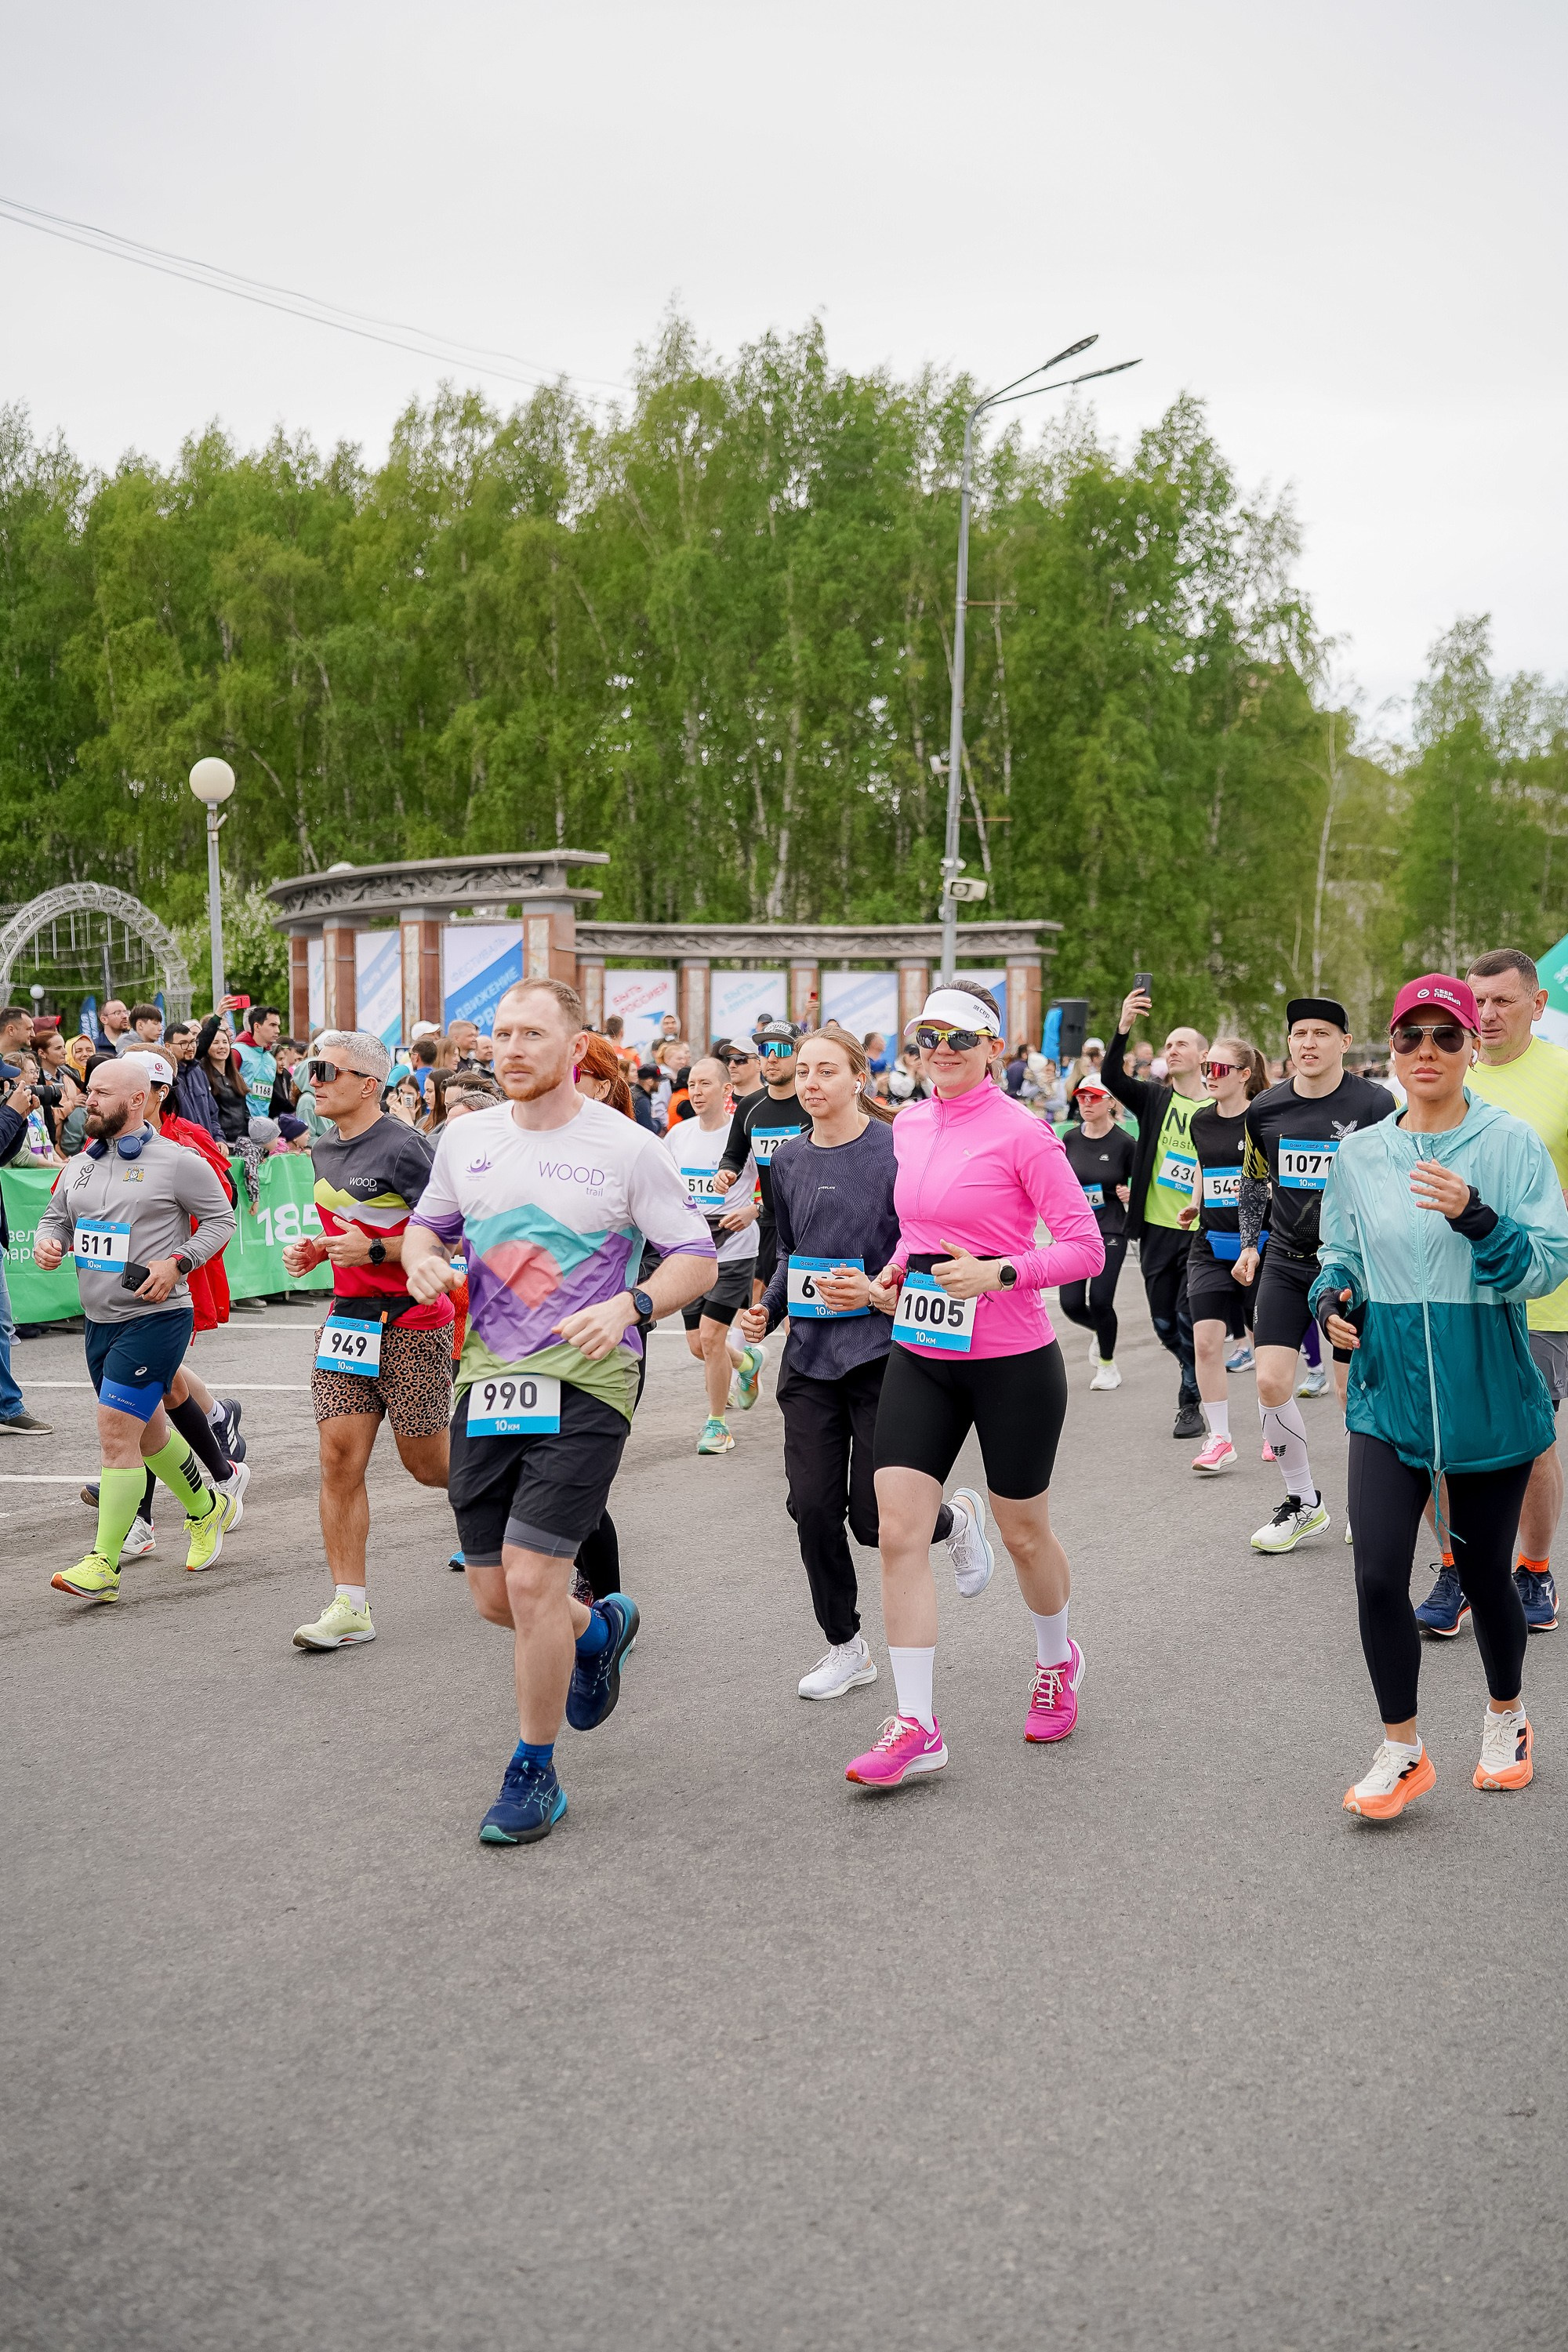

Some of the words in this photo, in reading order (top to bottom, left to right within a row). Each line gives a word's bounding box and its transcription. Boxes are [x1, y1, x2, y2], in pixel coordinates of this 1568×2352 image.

[350, 1177, 377, 1187] WOOD
[539, 1161, 604, 1186] WOOD
[688, 1178, 714, 1193] 516
[586, 1187, 604, 1197] trail
[257, 1203, 324, 1247] 185
[82, 1234, 112, 1256] 511
[904, 1294, 965, 1327] 1005
[332, 1333, 367, 1357] 949
[485, 1381, 537, 1411] 990
